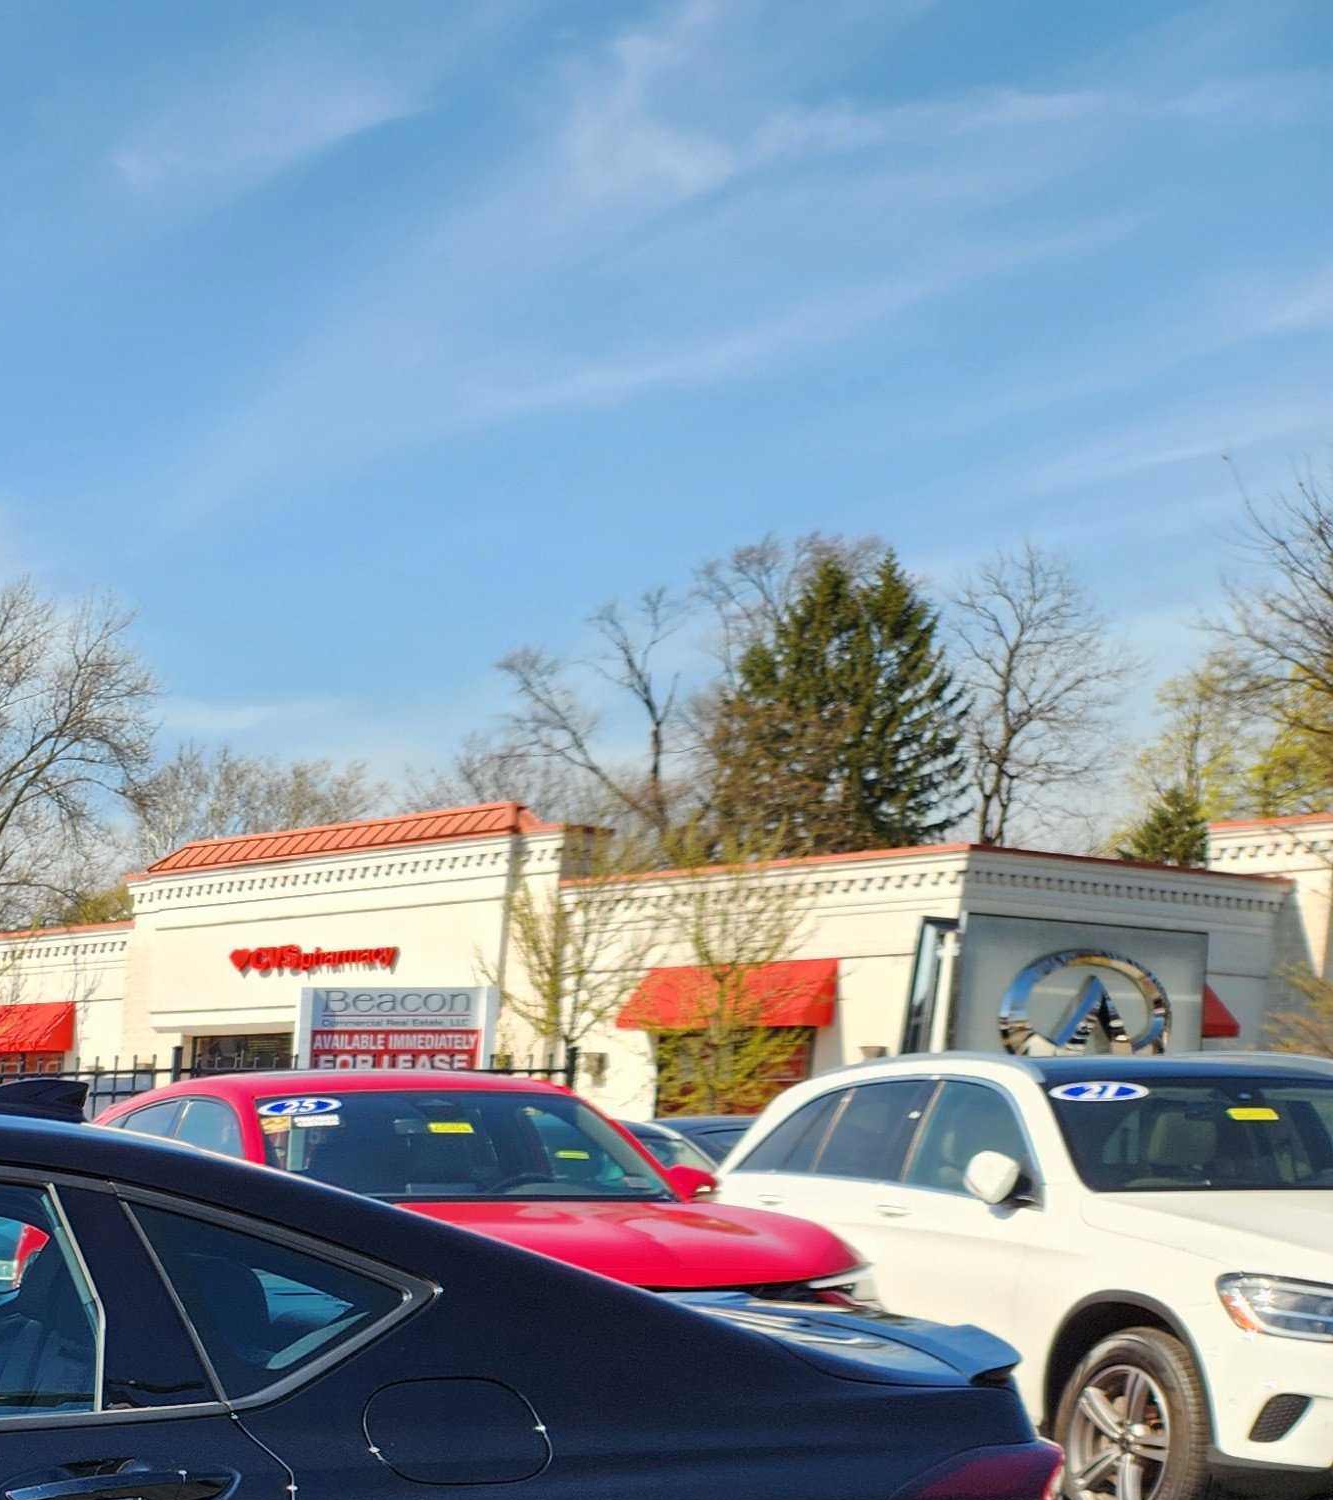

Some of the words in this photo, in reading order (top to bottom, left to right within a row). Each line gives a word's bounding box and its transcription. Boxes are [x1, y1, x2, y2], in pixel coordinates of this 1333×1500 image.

[250, 944, 301, 972] CVS
[300, 946, 399, 973] pharmacy
[322, 989, 472, 1013] Beacon
[321, 1019, 384, 1028] Commercial
[386, 1019, 409, 1027] Real
[450, 1018, 471, 1027] LLC
[313, 1033, 385, 1050] AVAILABLE
[388, 1033, 477, 1050] IMMEDIATELY
[282, 1098, 319, 1115] 25
